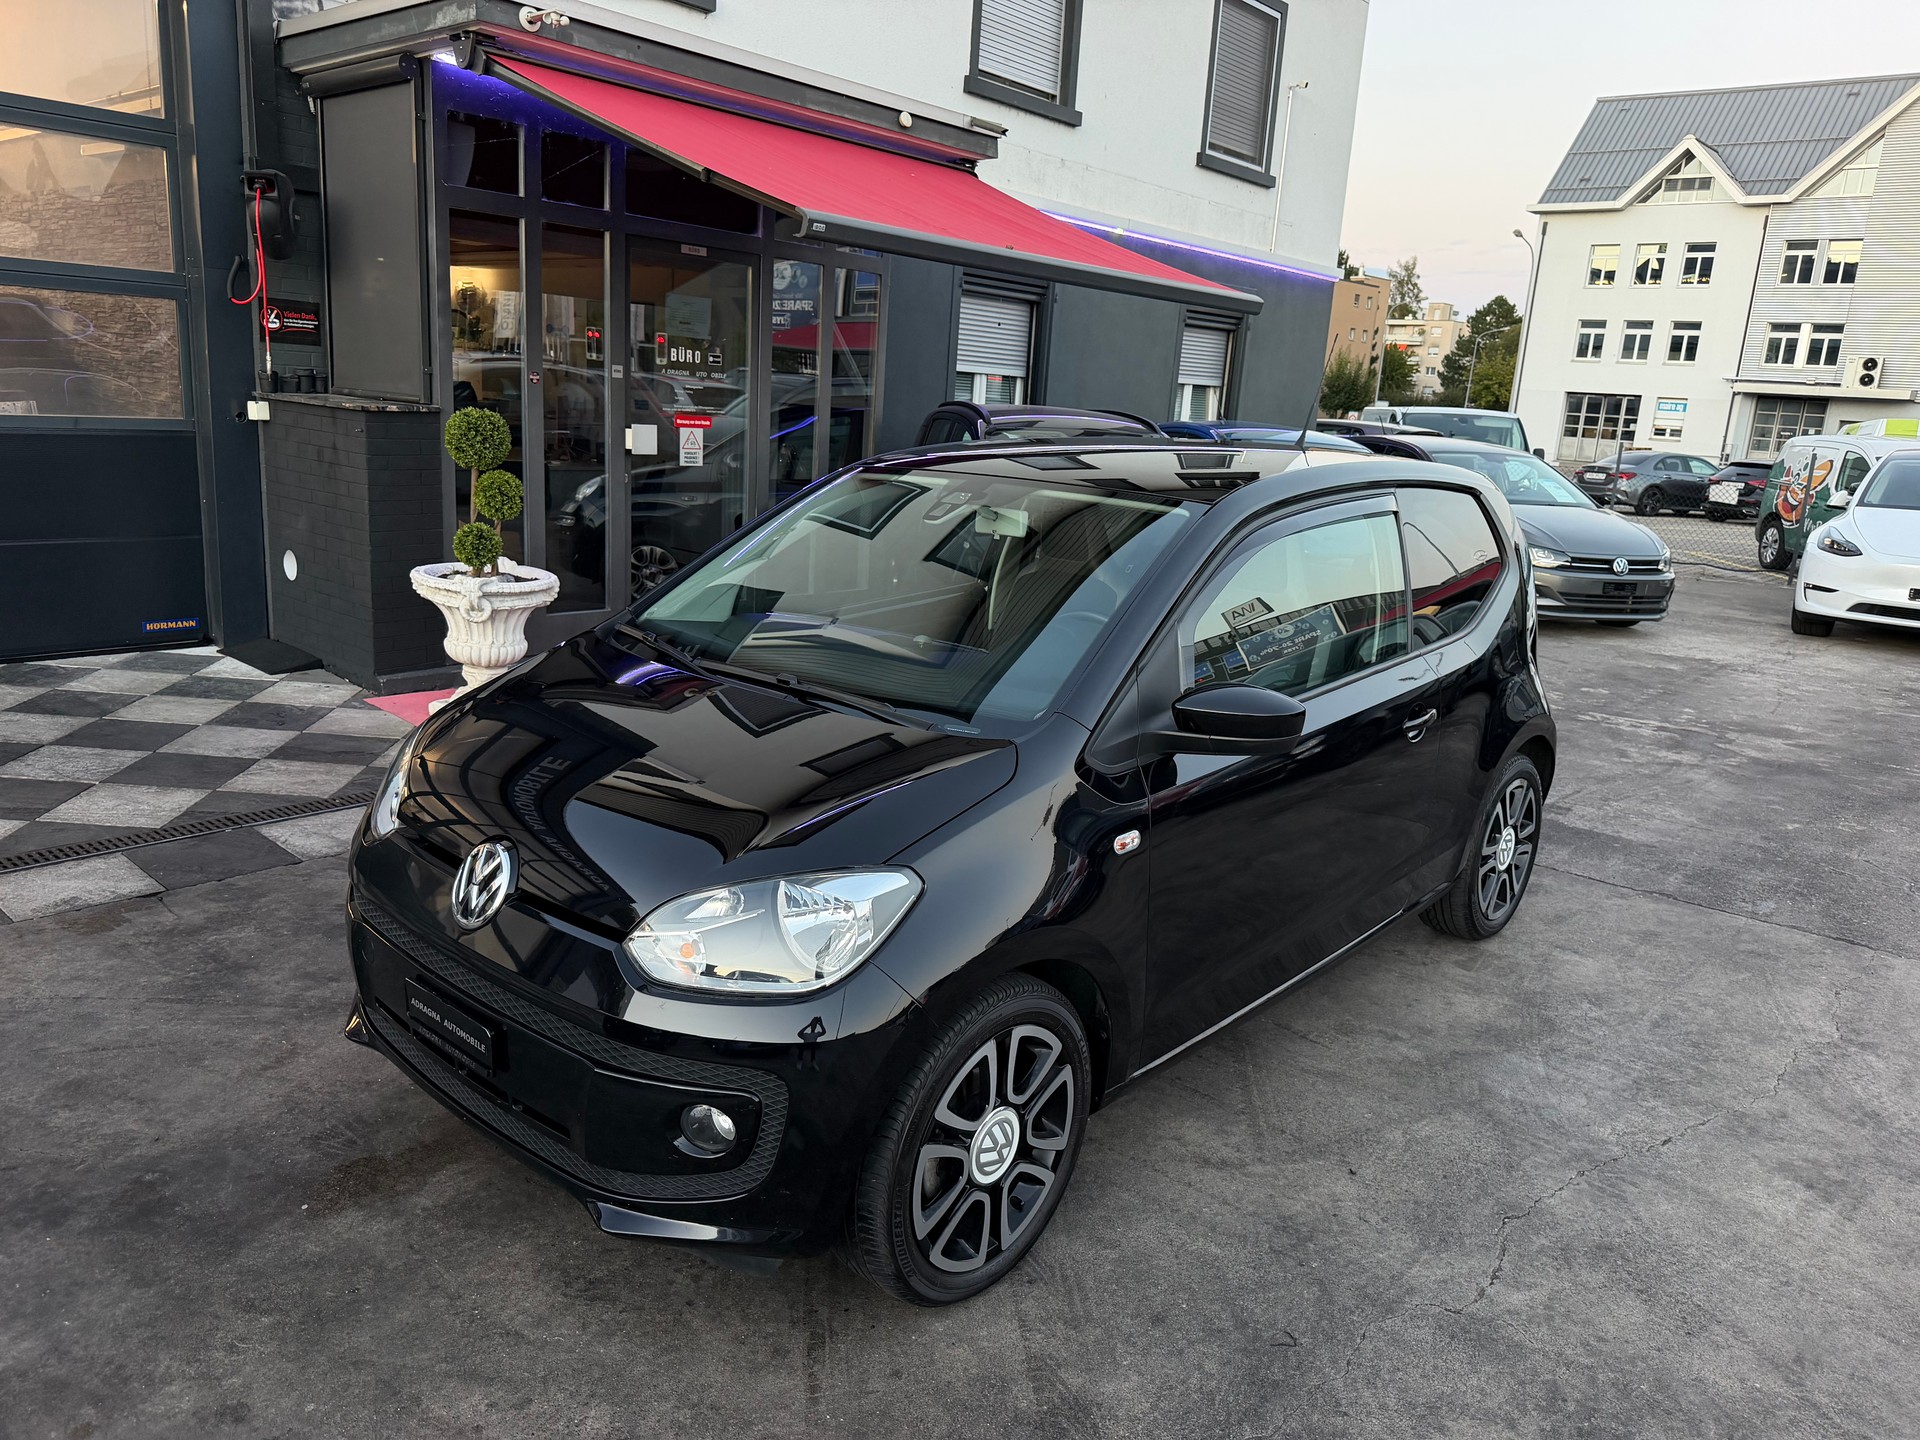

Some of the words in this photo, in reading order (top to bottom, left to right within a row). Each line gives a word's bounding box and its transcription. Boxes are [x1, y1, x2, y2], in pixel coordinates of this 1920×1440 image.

[284, 311, 300, 319] Vielen
[670, 347, 701, 364] BÜRO
[411, 997, 441, 1023] ADRAGNA
[443, 1019, 487, 1053] AUTOMOBILE
